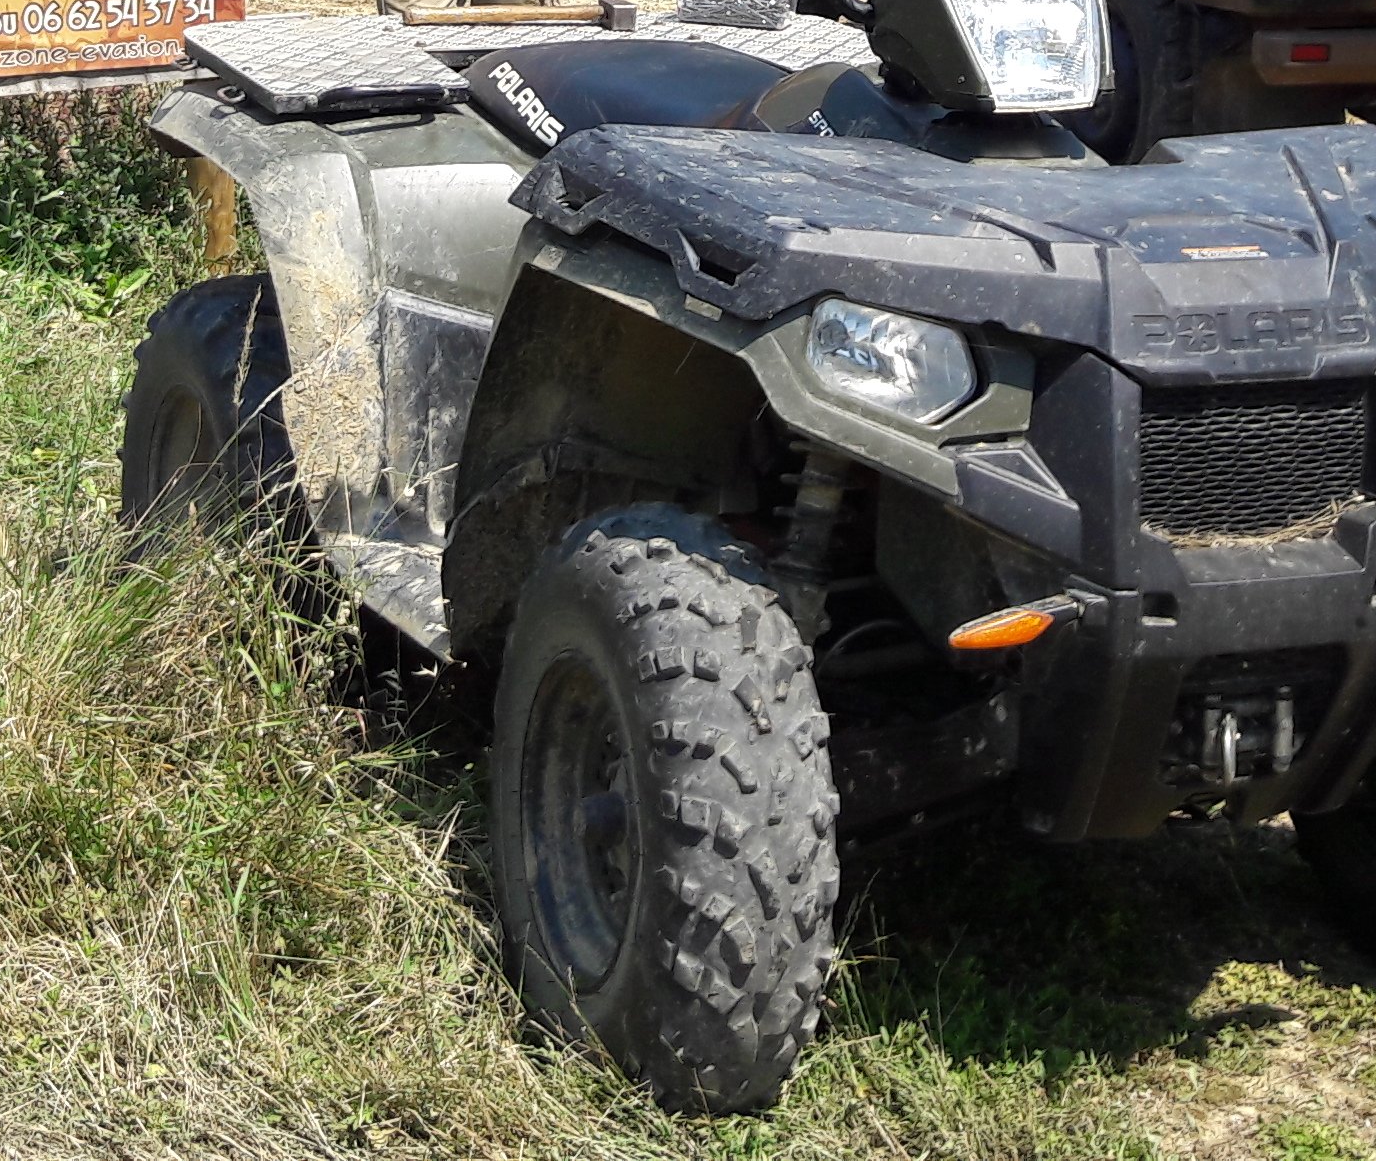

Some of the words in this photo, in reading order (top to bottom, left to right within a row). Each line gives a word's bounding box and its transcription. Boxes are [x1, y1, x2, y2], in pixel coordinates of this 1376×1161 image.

[23, 1, 64, 35] 06
[488, 61, 566, 147] POLARIS
[1129, 306, 1371, 355] POLARIS
